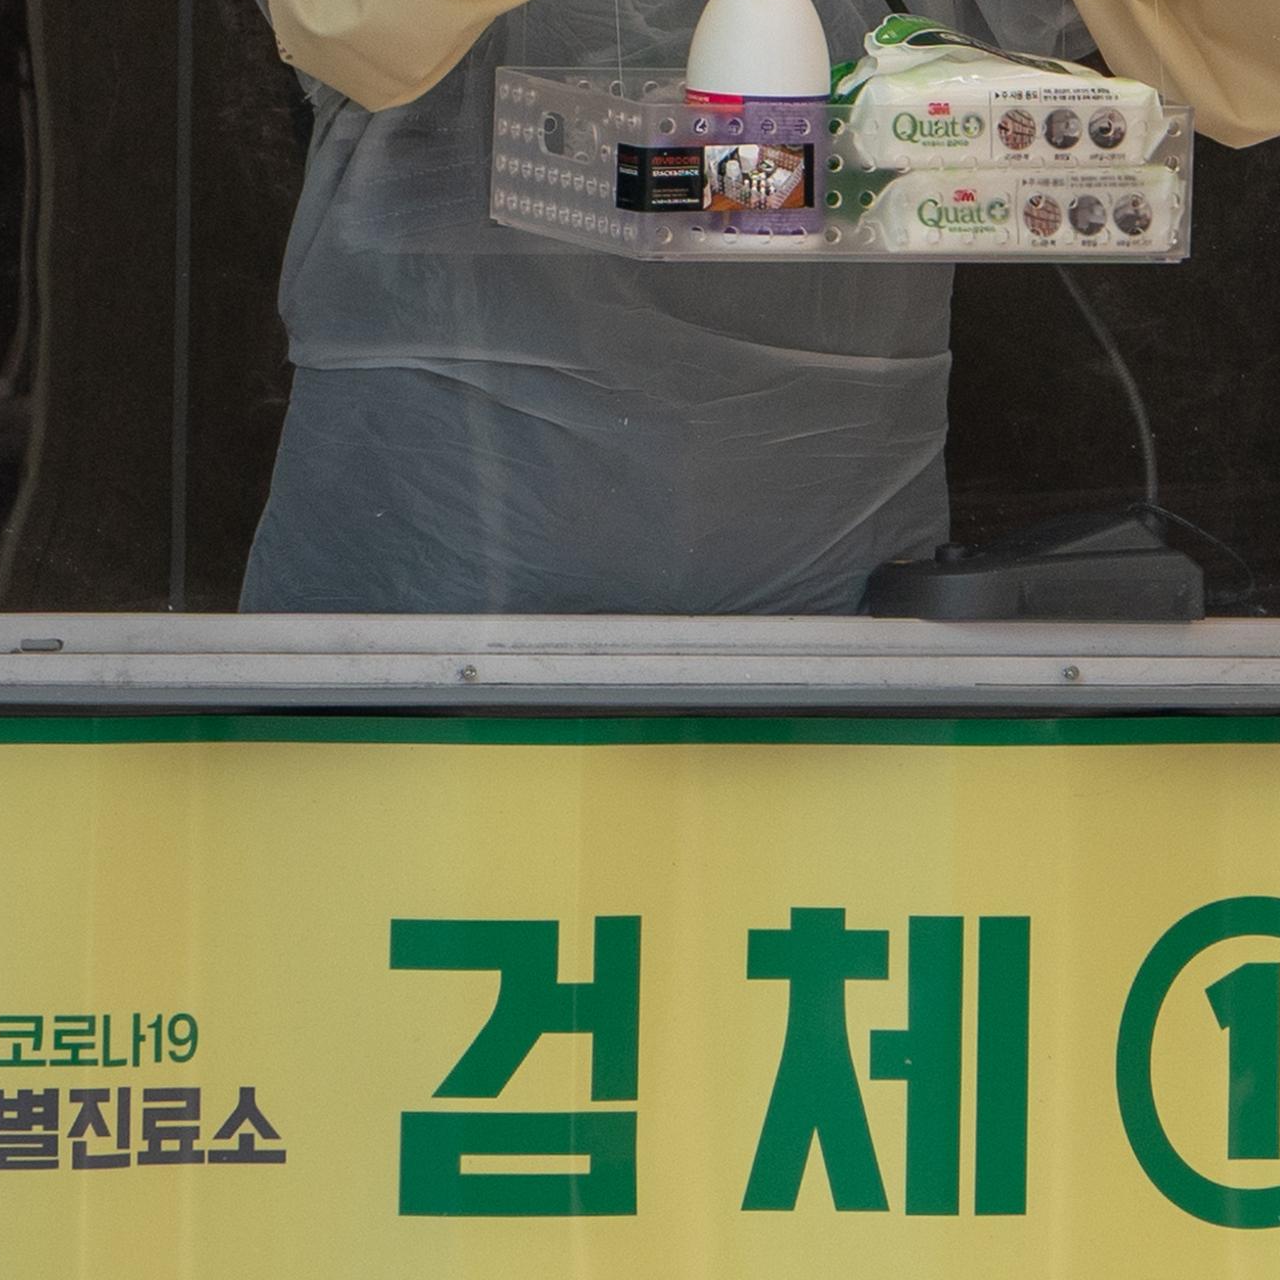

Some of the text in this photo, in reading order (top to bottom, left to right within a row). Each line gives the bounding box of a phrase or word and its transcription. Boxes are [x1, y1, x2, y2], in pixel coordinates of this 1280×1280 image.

[927, 102, 951, 116] 3M
[892, 112, 960, 143] Quat
[953, 189, 976, 202] 3M
[917, 198, 986, 229] Quat
[389, 907, 1032, 1218] 검체
